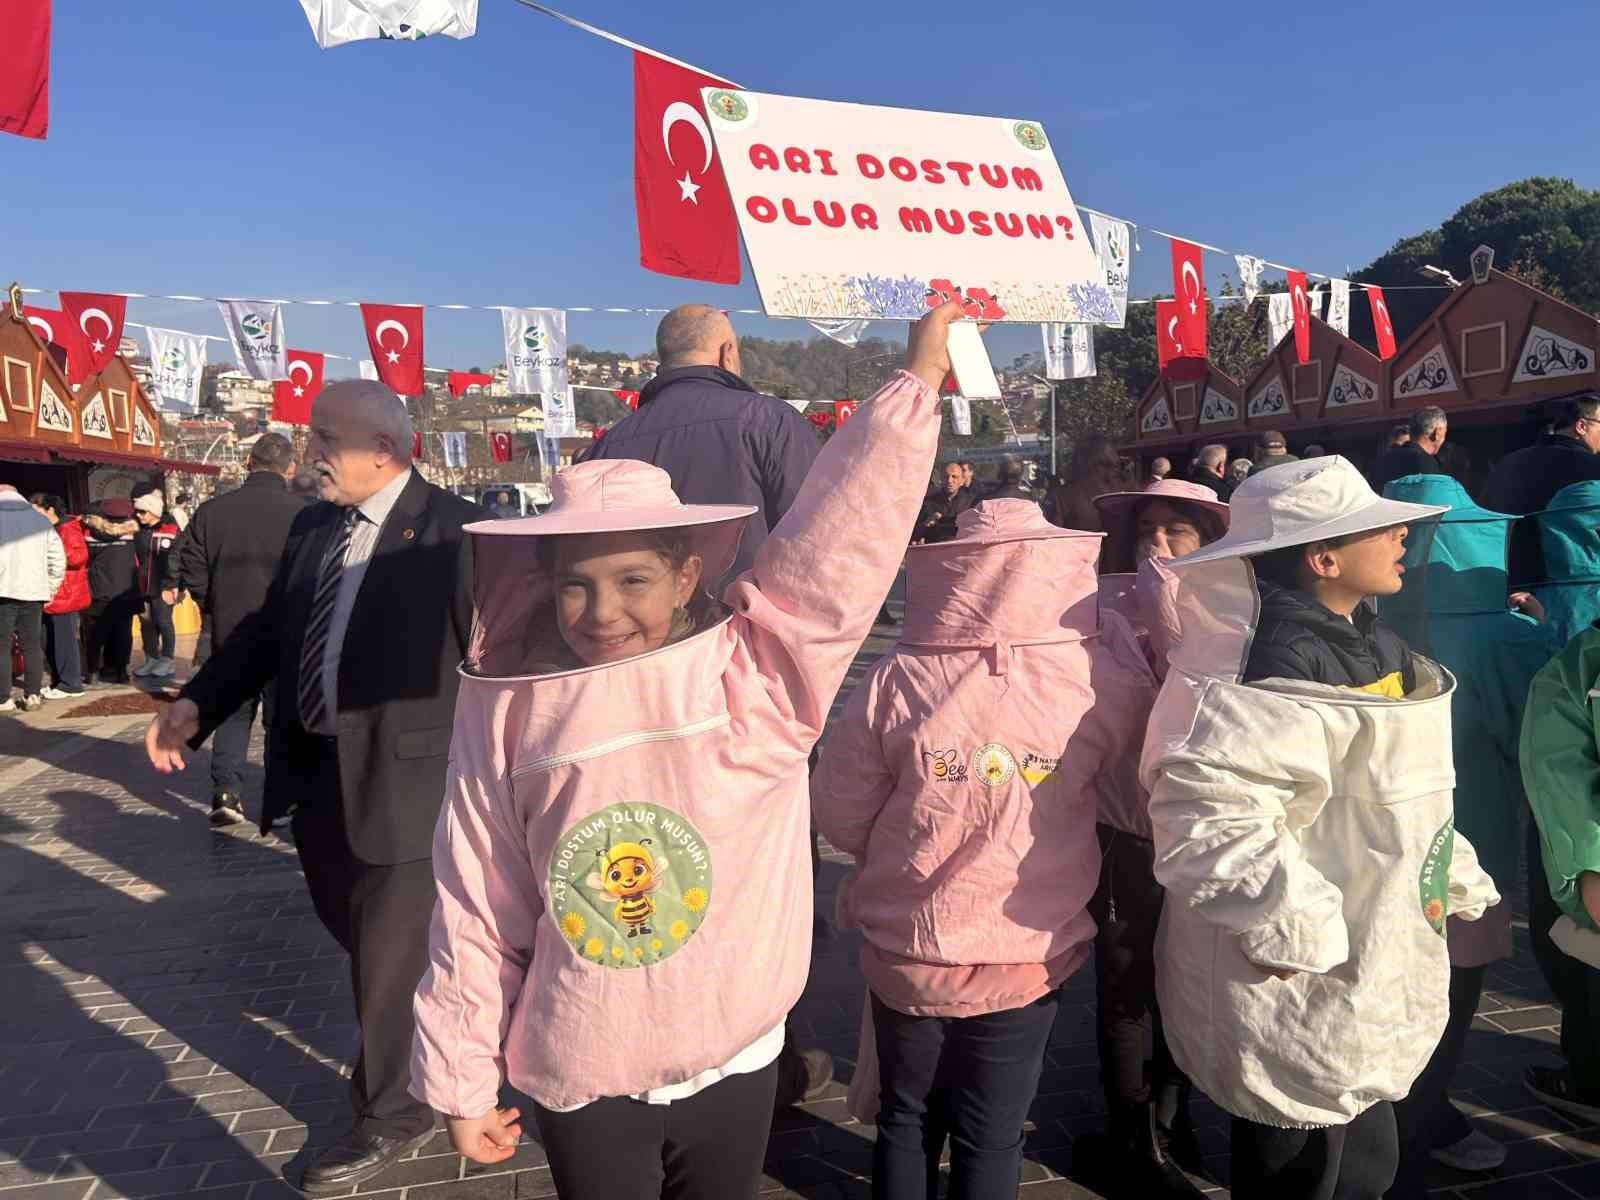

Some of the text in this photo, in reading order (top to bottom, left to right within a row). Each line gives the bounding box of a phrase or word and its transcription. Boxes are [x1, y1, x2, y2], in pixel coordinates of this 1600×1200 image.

[748, 143, 1043, 192] ARI DOSTUM
[745, 195, 1074, 241] OLUR MUSUN?
[513, 354, 560, 369] Beykoz
[555, 810, 708, 902] ARI DOSTUM OLUR MUSUN?
[1423, 860, 1436, 886] ARI
